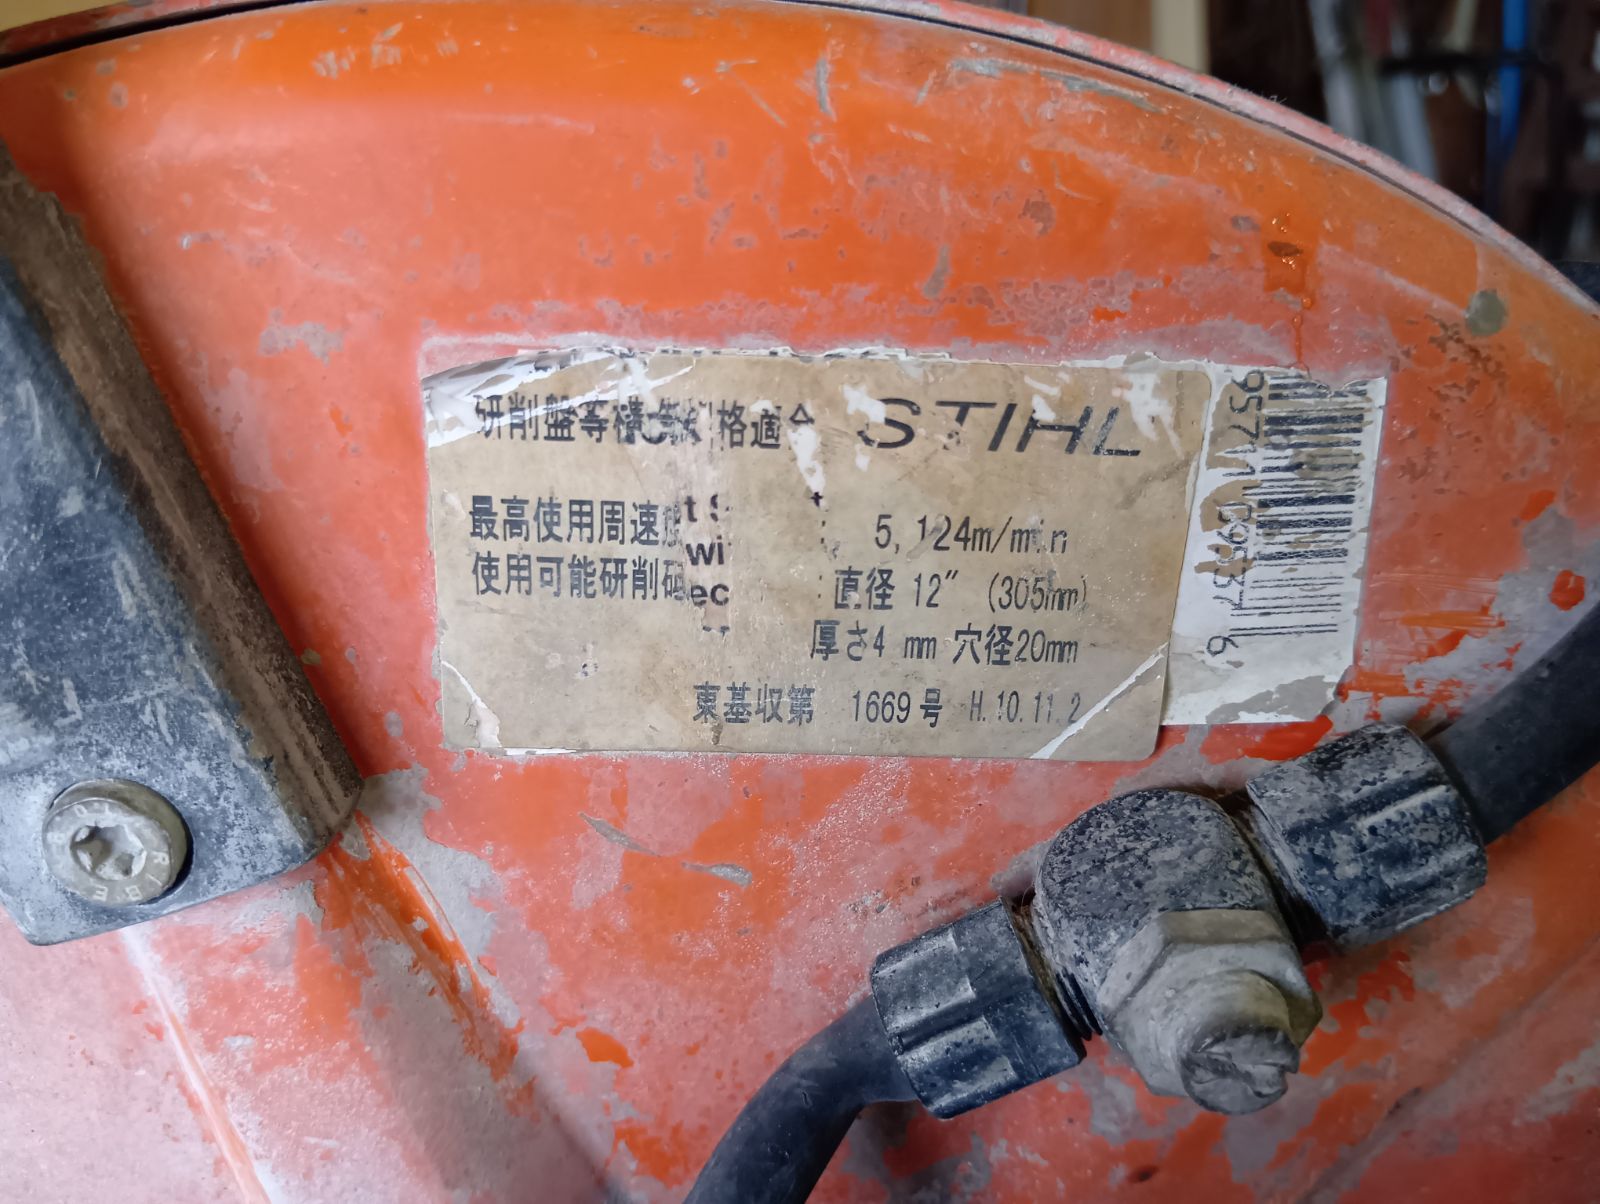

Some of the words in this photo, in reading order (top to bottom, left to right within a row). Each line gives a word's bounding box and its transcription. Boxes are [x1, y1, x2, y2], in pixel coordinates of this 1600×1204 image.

[856, 397, 1142, 457] STIHL
[469, 494, 682, 548] 最高使用周速
[834, 566, 896, 611] 直径
[853, 689, 911, 724] 1669
[919, 687, 944, 729] 号
